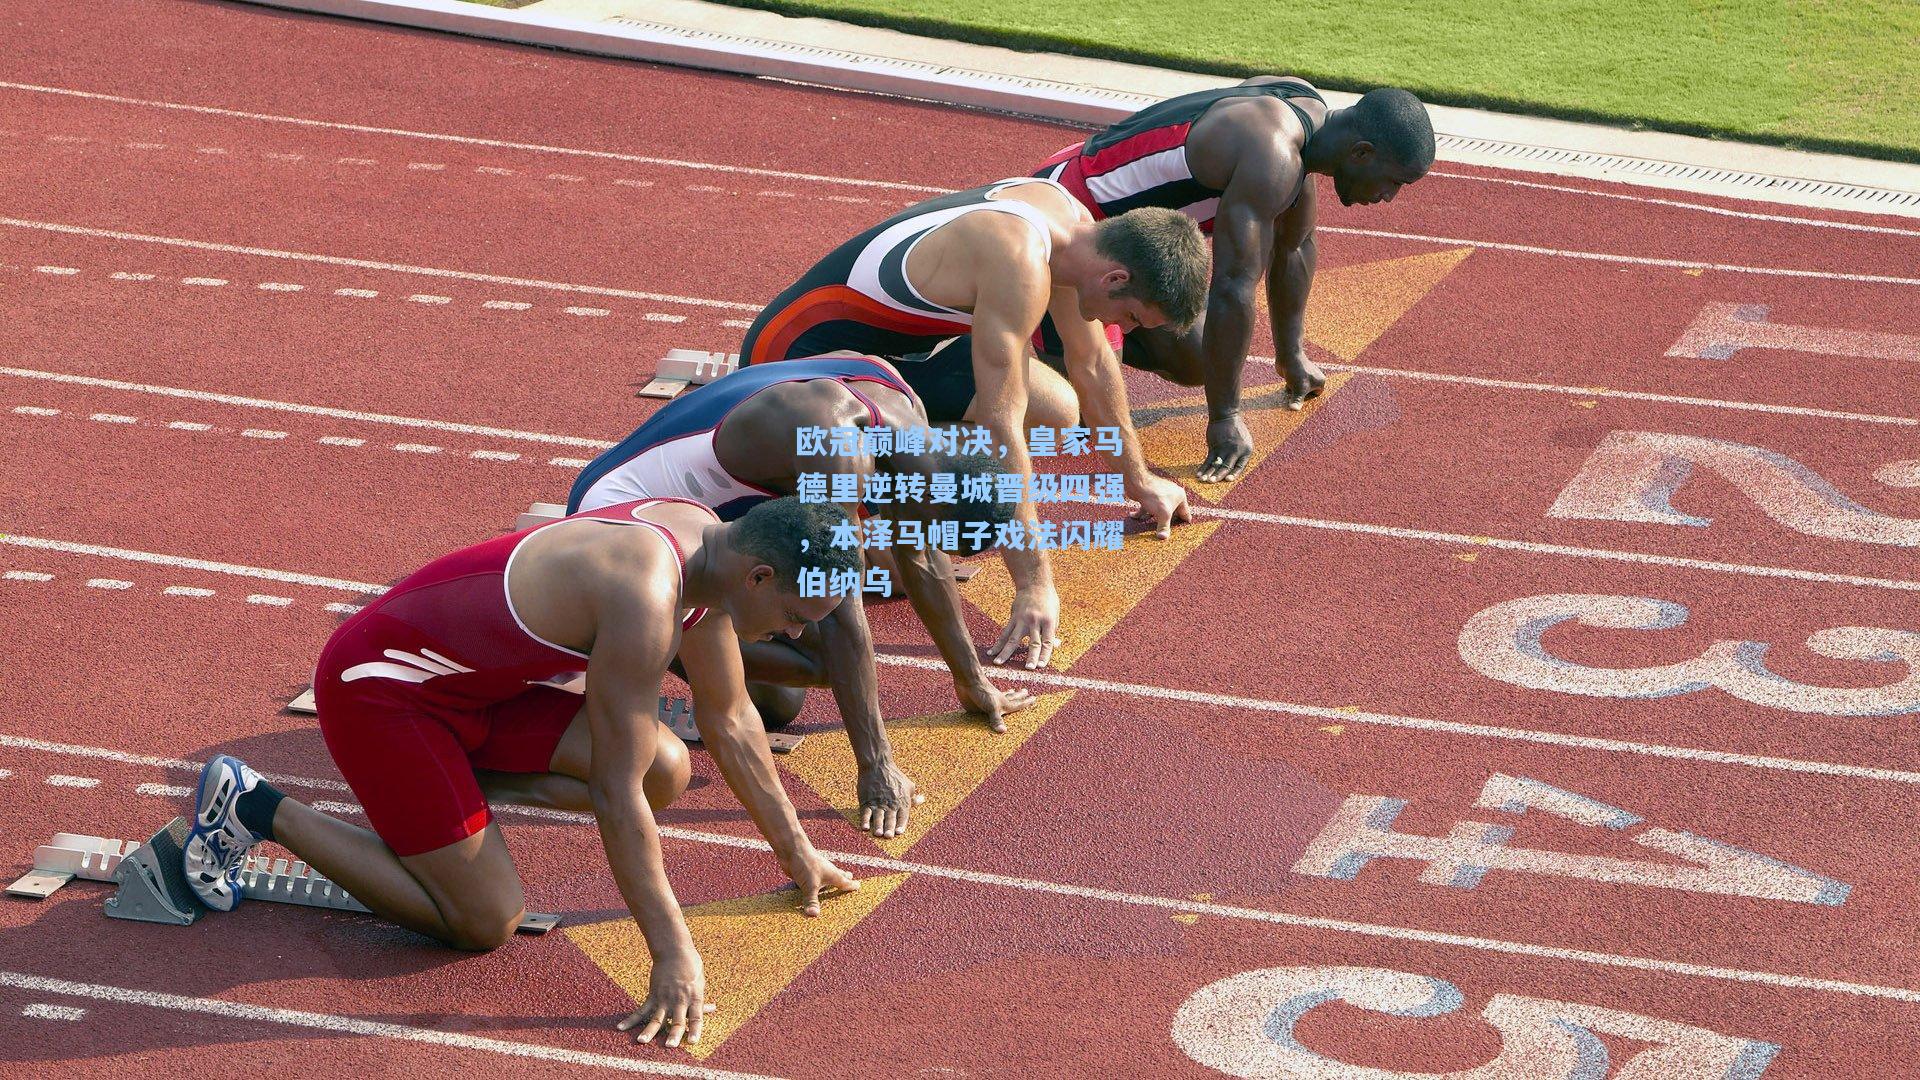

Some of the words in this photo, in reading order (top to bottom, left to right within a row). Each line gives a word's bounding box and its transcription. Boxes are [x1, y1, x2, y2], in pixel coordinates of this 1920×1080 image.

[1457, 593, 1920, 717] 3
[1291, 773, 1851, 906] 4
[1170, 966, 1783, 1080] 5
